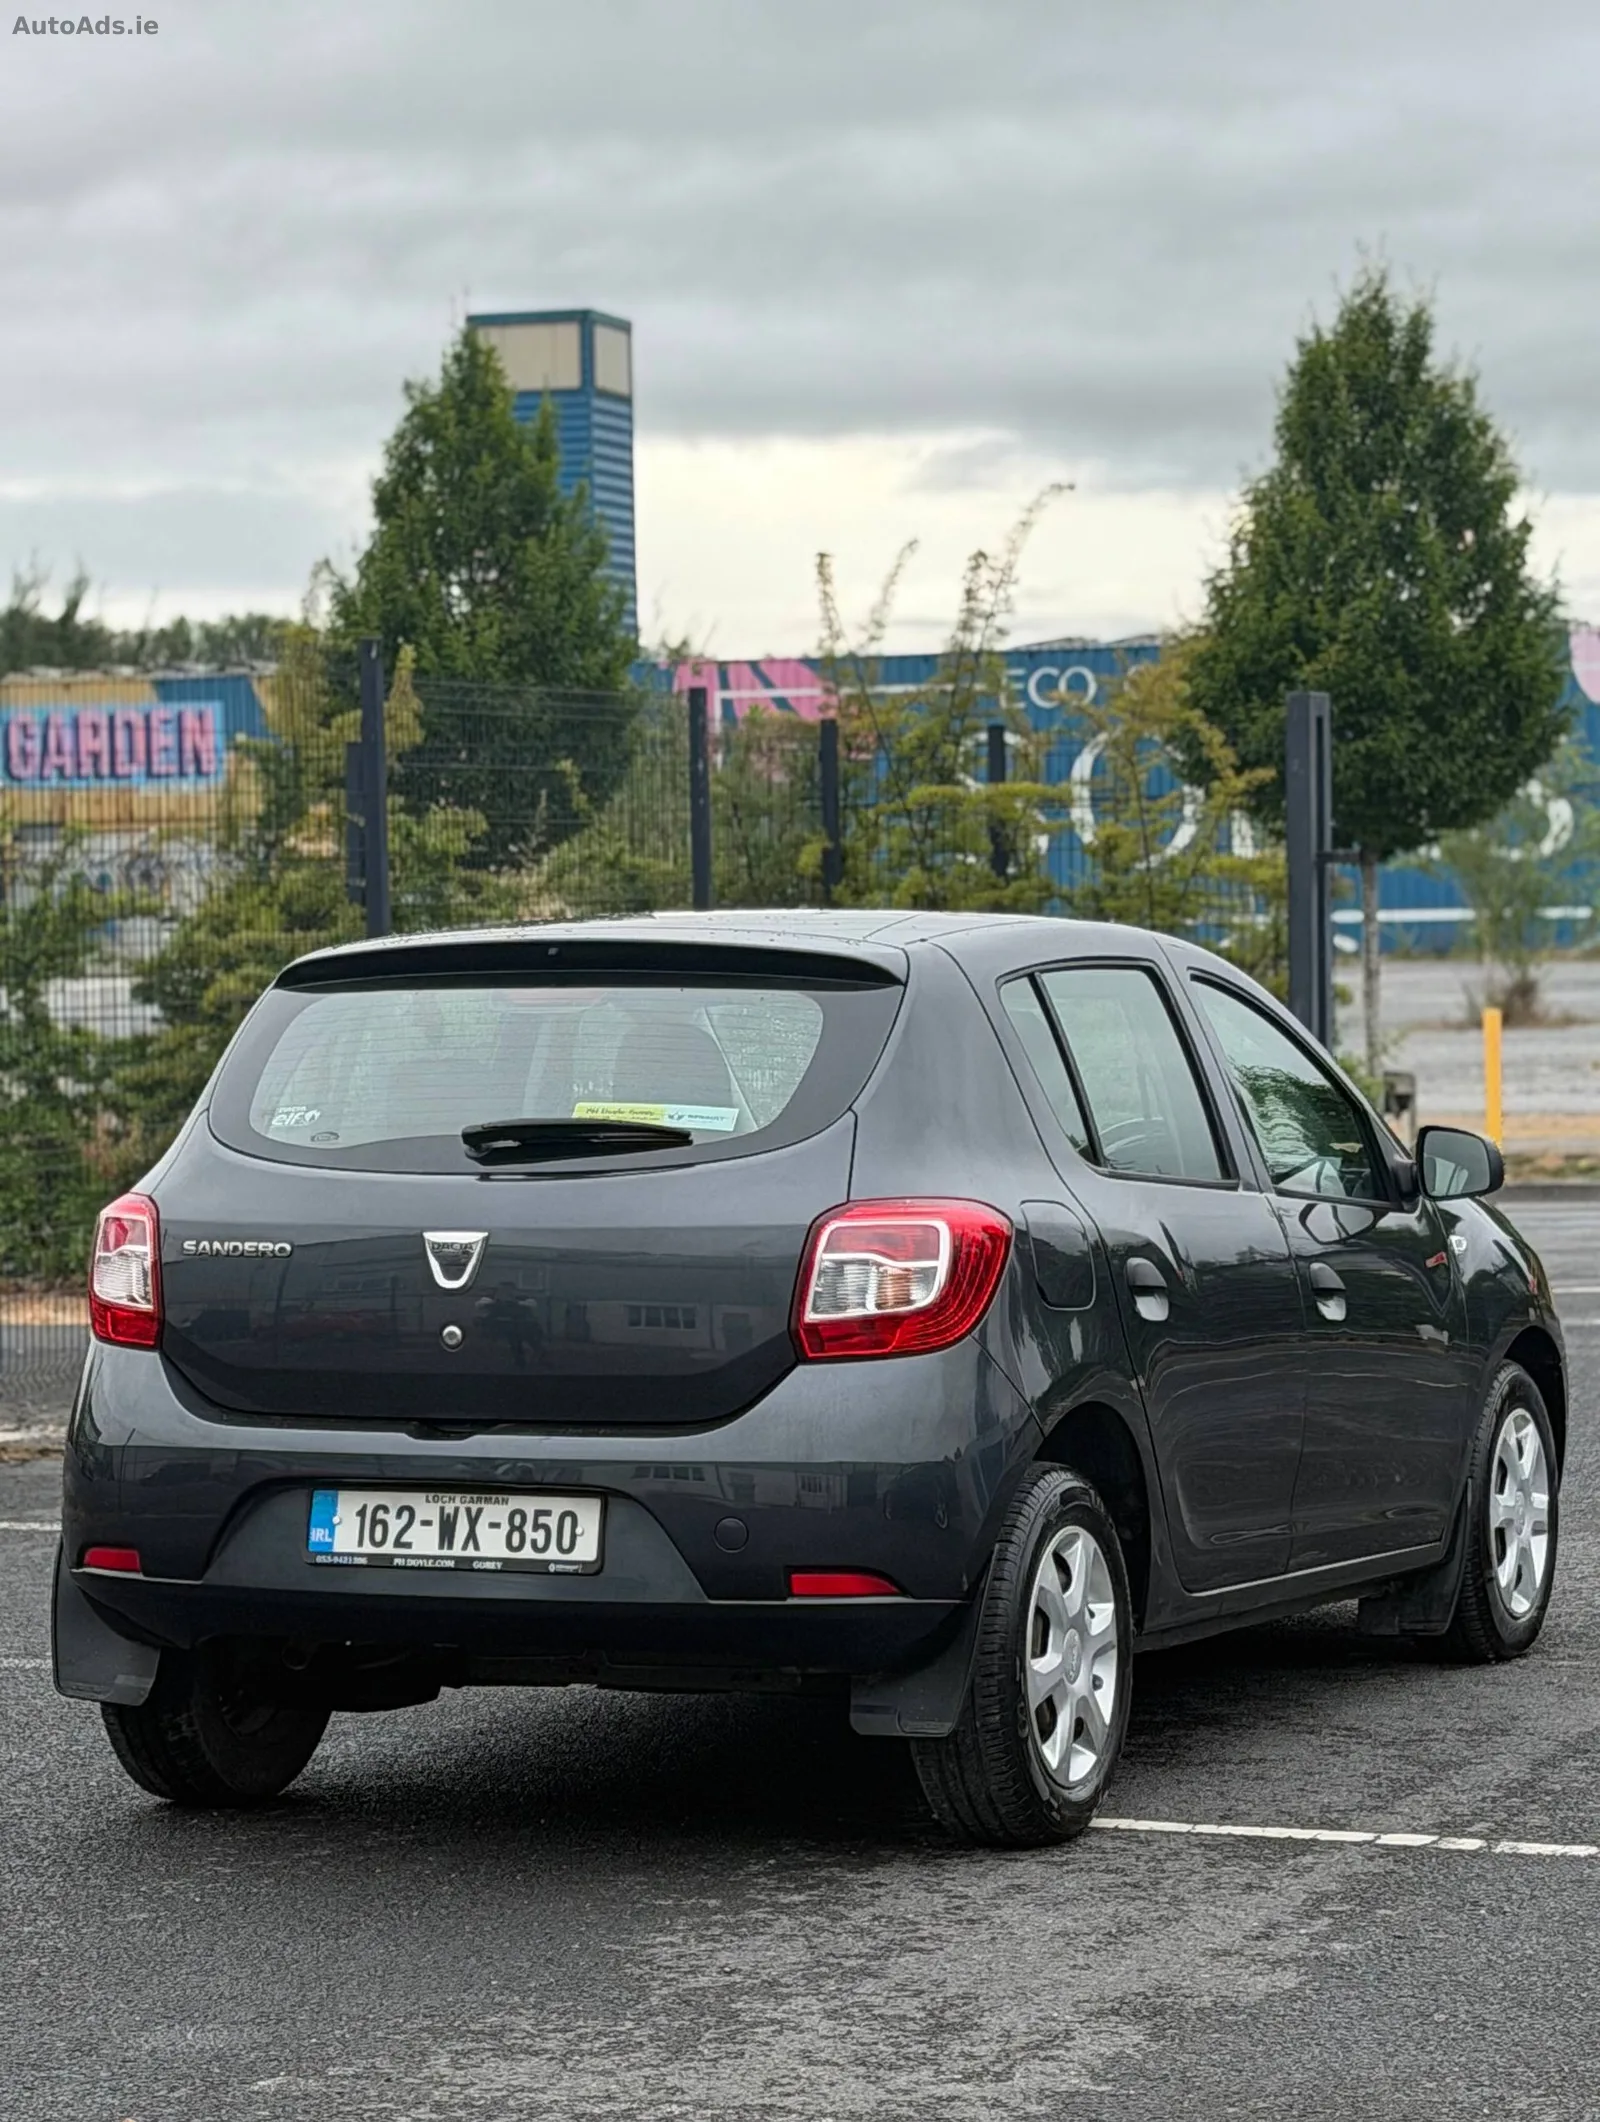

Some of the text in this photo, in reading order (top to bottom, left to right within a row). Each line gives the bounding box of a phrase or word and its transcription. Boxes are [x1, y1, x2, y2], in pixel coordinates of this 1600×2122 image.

[999, 665, 1098, 709] ECO
[8, 706, 217, 779] GARDEN
[181, 1240, 292, 1258] SANDERO
[429, 1241, 478, 1254] DACIA
[425, 1494, 510, 1506] LOCH GARMAN
[310, 1527, 333, 1542] IRL
[355, 1503, 579, 1555] 162-WX-850
